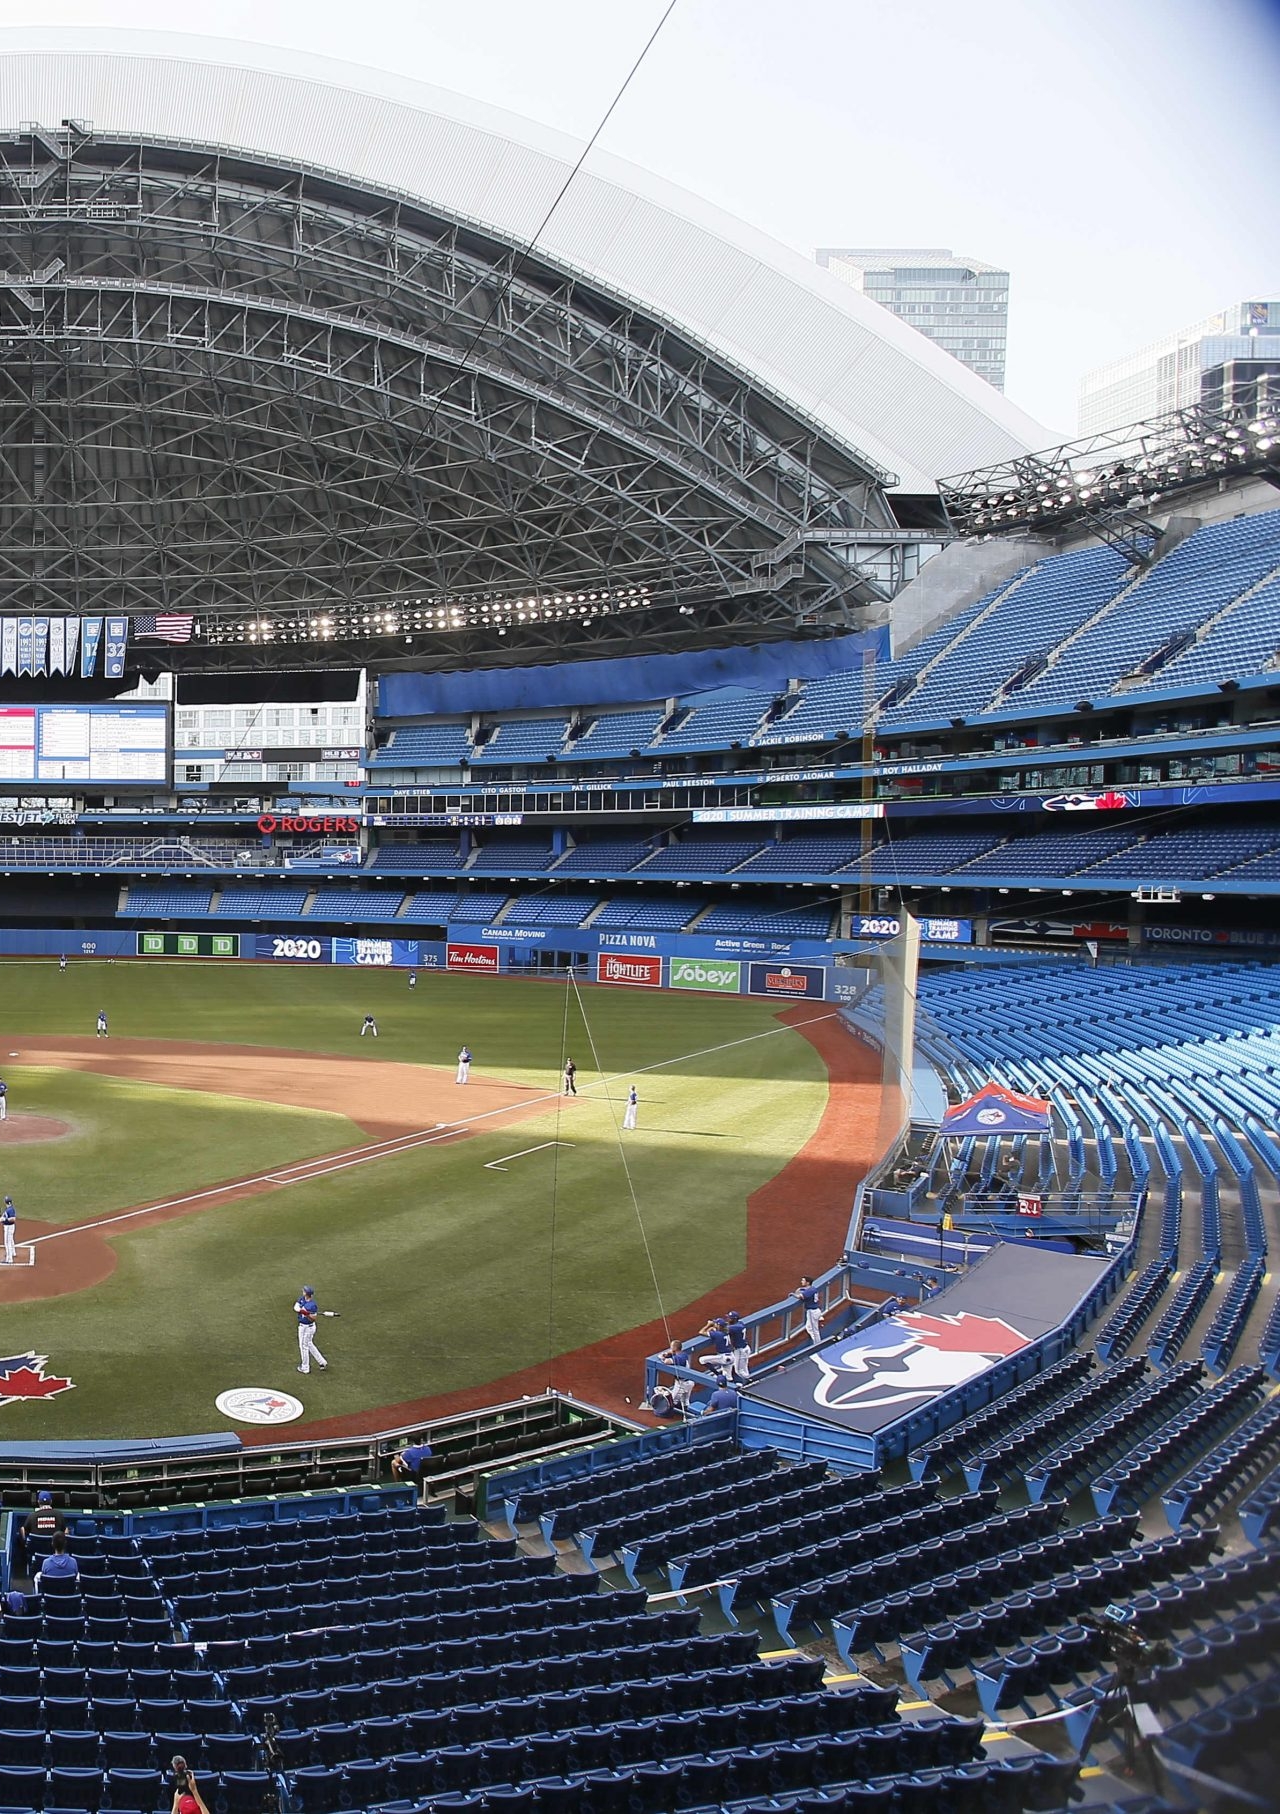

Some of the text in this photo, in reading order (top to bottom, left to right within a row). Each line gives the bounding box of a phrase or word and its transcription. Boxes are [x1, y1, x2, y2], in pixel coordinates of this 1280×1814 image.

[107, 642, 126, 658] 32
[758, 738, 782, 746] JACKIE
[784, 734, 824, 744] ROBINSON
[883, 767, 899, 775] ROY
[901, 764, 942, 774] HALLADAY
[766, 774, 800, 782] ROBERTO
[802, 772, 834, 781] ALOMAR
[698, 806, 870, 821] 2020 SUMMER TRAINING CAMP
[281, 817, 358, 832] ROGERS
[482, 928, 546, 938] CANADA MOVING
[860, 920, 900, 934] 2020
[599, 933, 656, 948] PIZZA NOVA
[928, 931, 959, 940] CAMP
[1144, 928, 1212, 942] TORONTO
[1230, 932, 1264, 944] BLUE
[146, 938, 162, 950] TD
[180, 938, 196, 950] TD
[214, 939, 231, 952] TD
[272, 938, 321, 959] 2020
[356, 940, 392, 948] SUMMER
[714, 940, 790, 950] Active Green Ross
[356, 954, 392, 966] CAMP
[448, 951, 496, 966] Tim Hortons
[834, 984, 857, 994] 328
